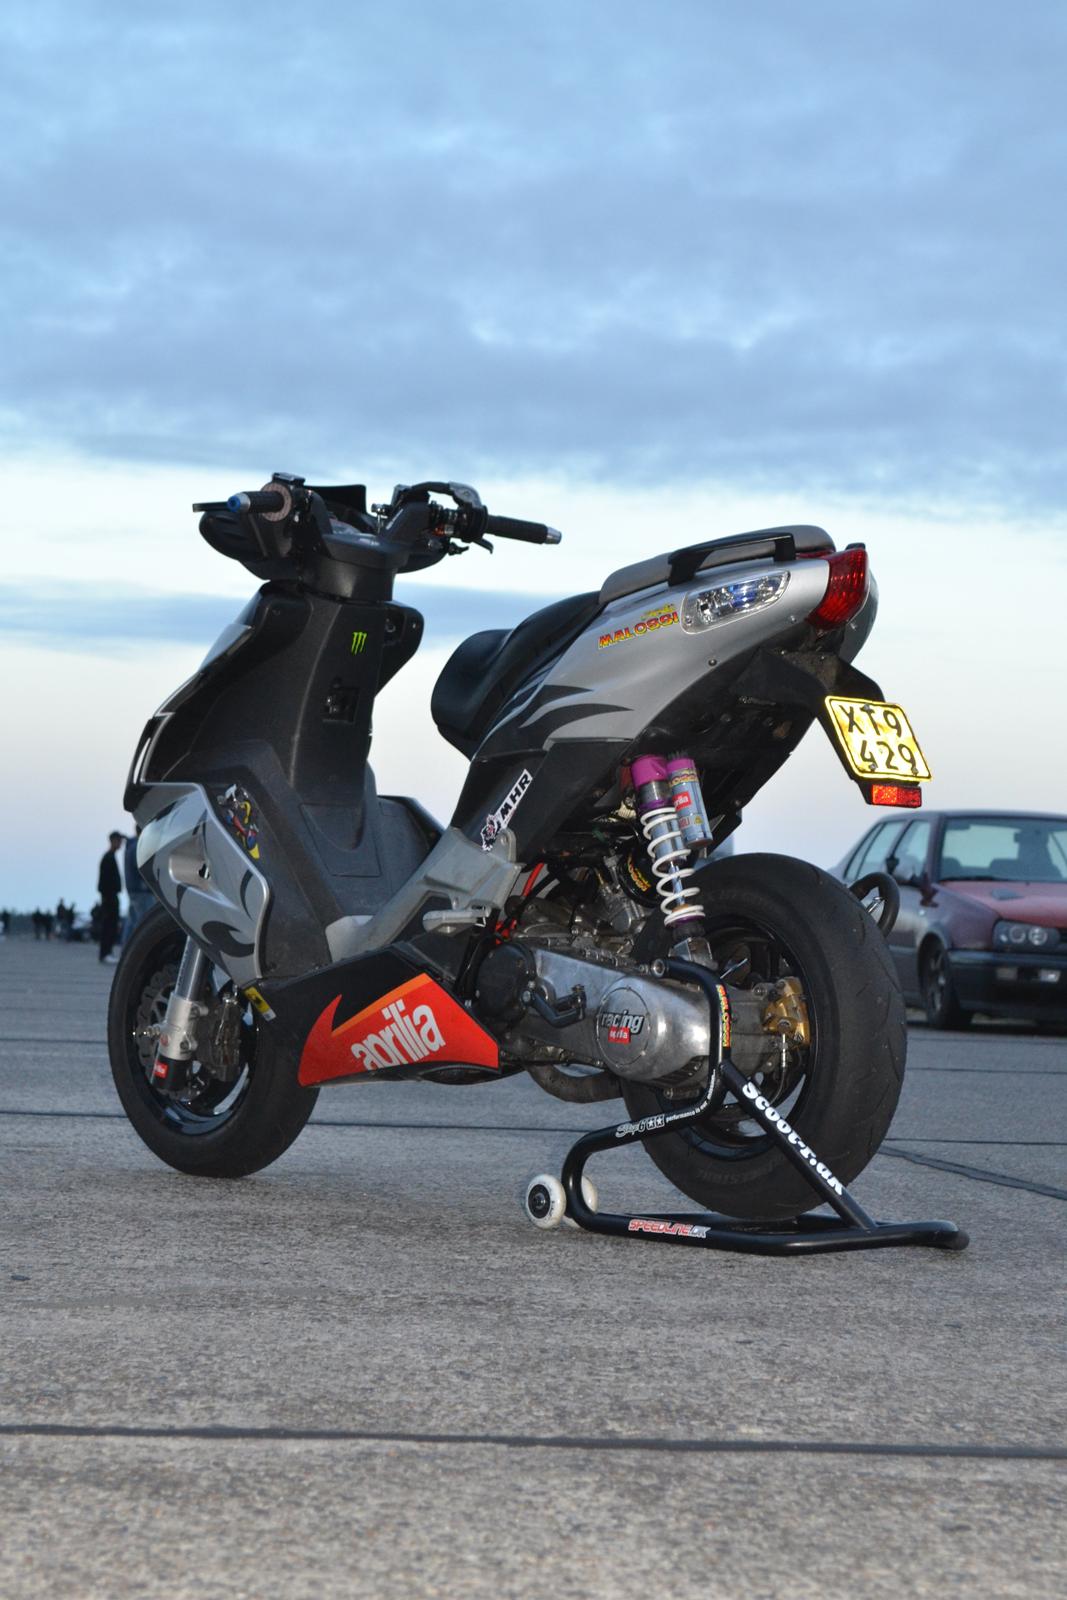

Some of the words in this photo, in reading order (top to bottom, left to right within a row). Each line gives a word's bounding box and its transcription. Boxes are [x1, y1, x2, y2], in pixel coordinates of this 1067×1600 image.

[598, 611, 679, 649] MALOSSI
[860, 740, 918, 776] 429
[500, 774, 531, 821] MHR
[351, 999, 446, 1071] aprilia
[601, 1010, 644, 1034] racing
